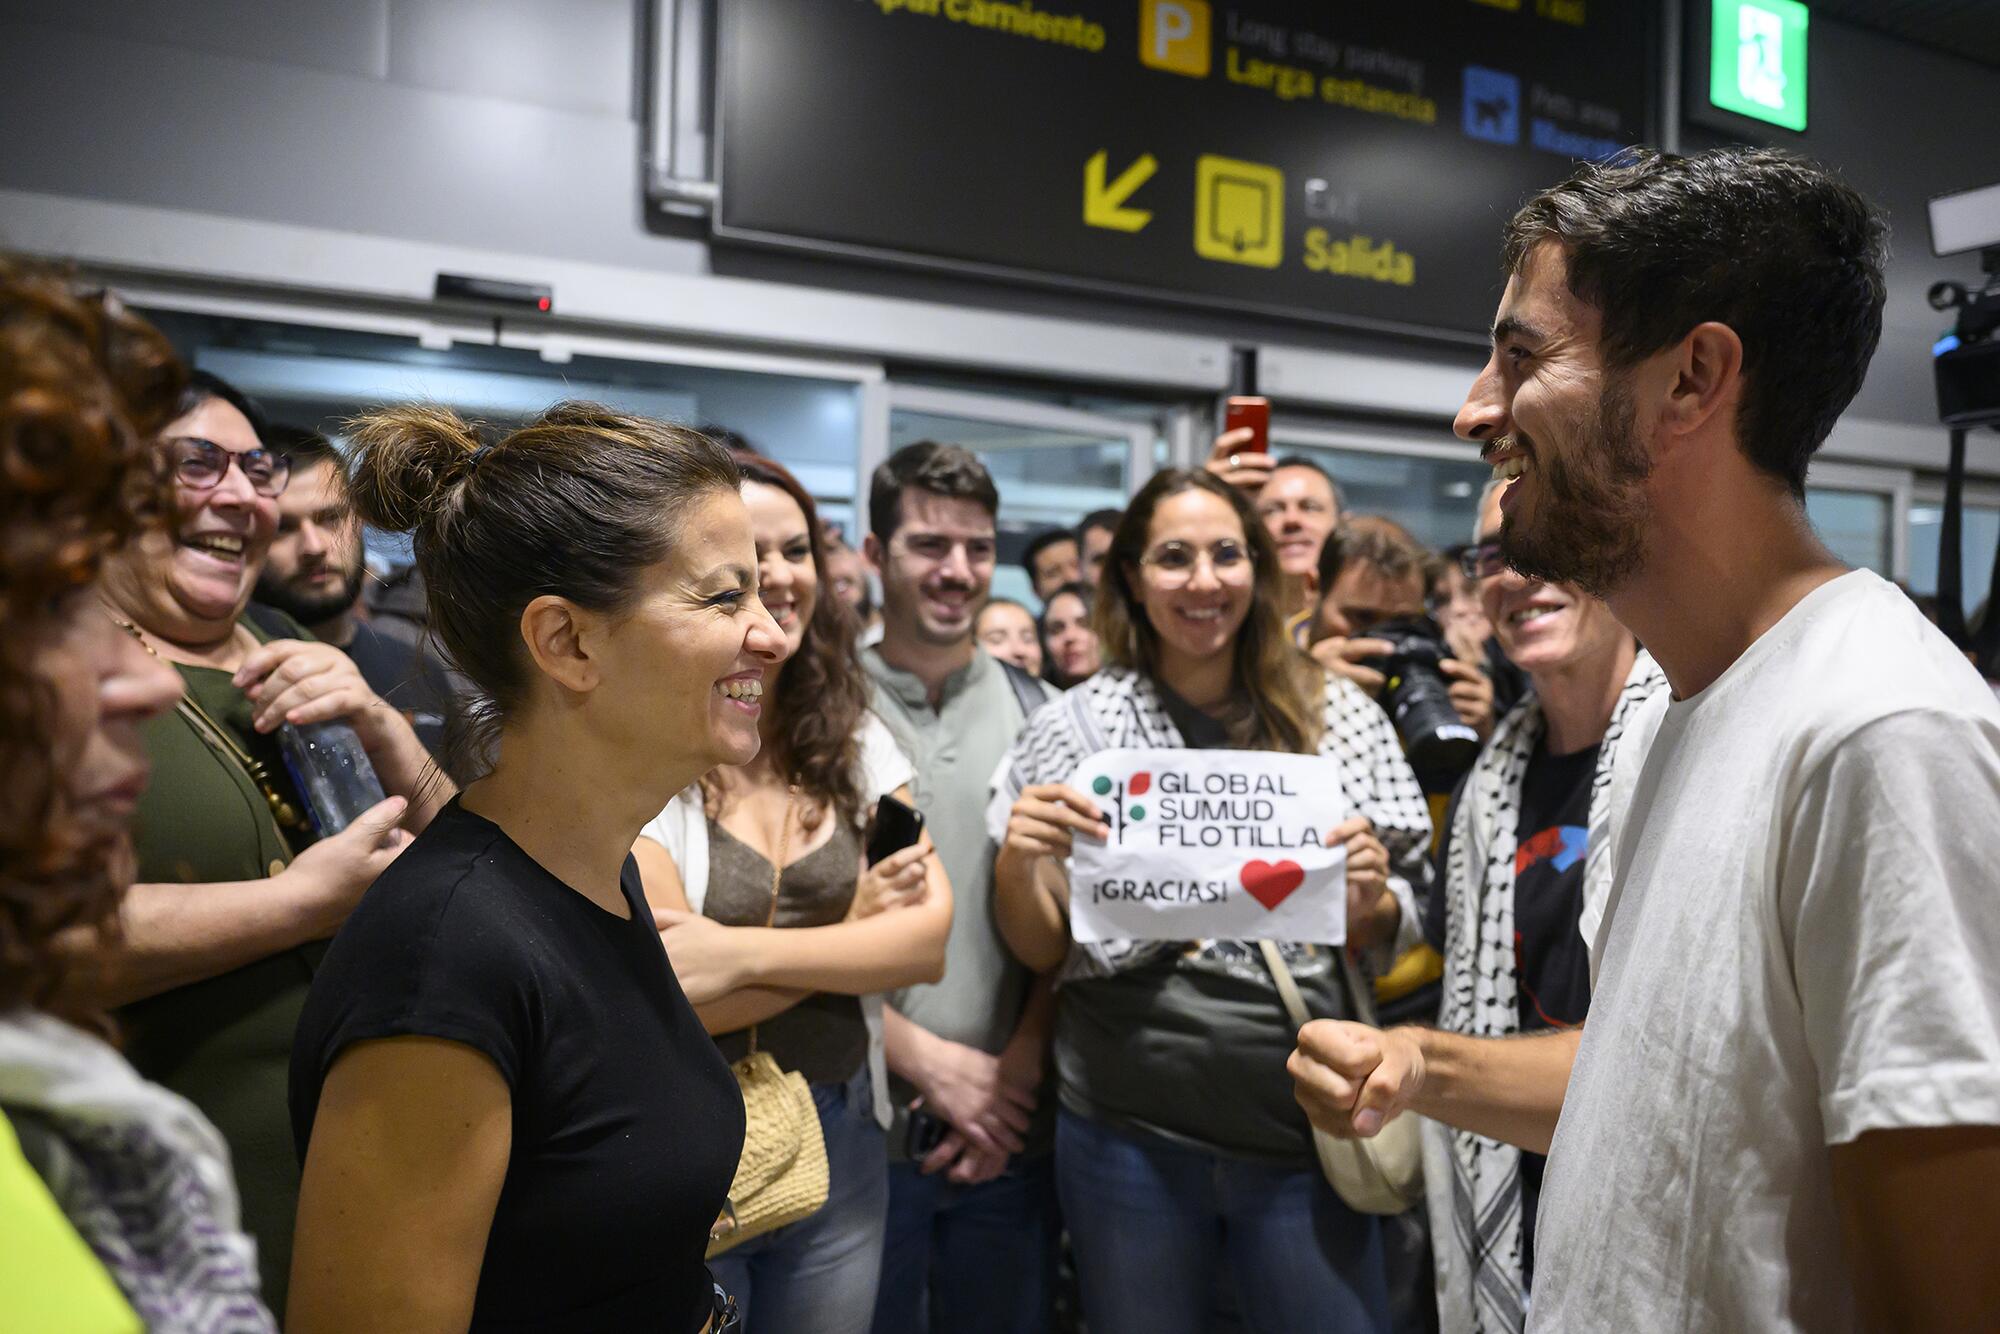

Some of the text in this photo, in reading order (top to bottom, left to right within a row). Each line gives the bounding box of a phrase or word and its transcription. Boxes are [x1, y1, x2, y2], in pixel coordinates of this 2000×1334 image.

[872, 0, 1105, 51] parcamiento
[1226, 47, 1315, 100] Larga
[1304, 226, 1415, 285] Salida
[1159, 772, 1298, 796] GLOBAL
[1159, 798, 1275, 822] SUMUD
[1158, 824, 1322, 848] FLOTILLA
[1092, 879, 1228, 903] ¡GRACIAS!
